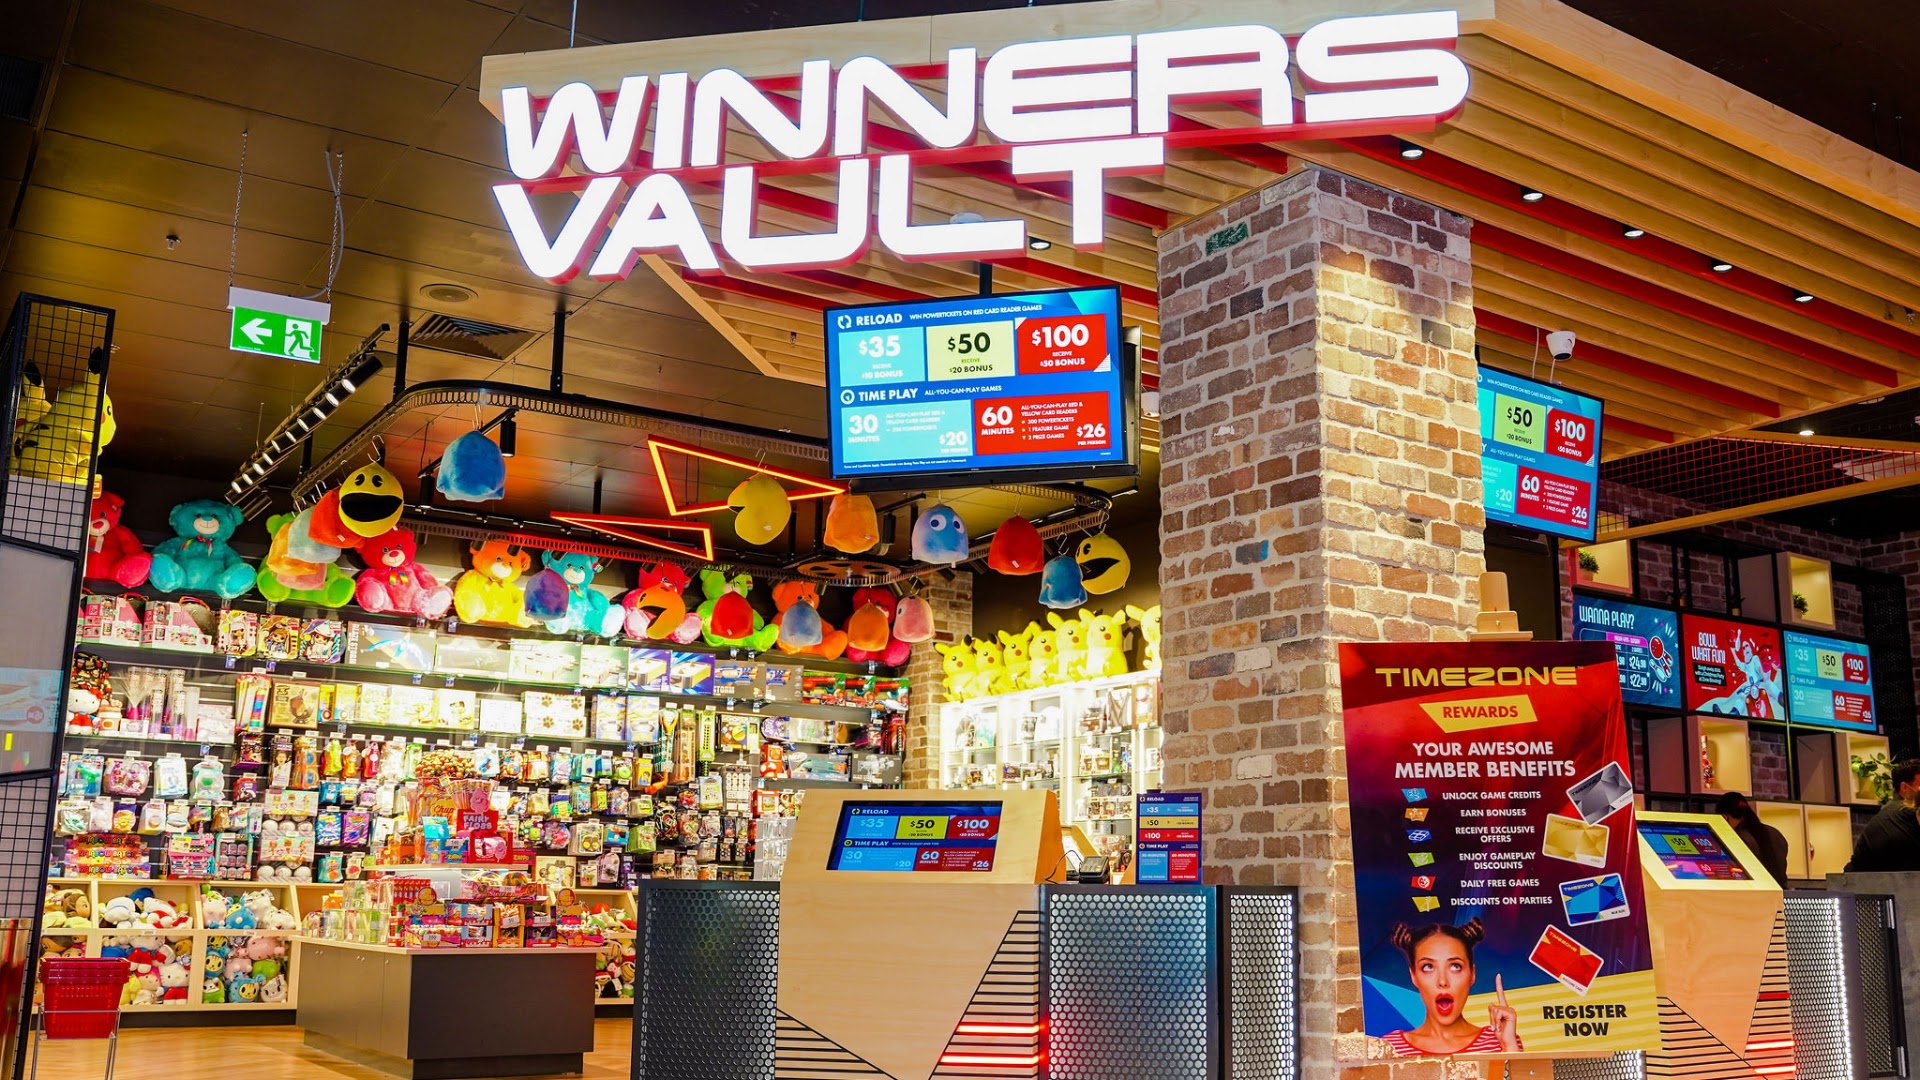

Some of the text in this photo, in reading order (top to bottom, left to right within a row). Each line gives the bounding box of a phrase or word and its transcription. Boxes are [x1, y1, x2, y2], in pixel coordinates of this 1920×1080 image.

[501, 9, 1470, 181] WINNERS
[491, 136, 1165, 281] VAULT
[922, 310, 962, 319] POWERTICKETS
[984, 307, 1000, 315] CARD
[1022, 304, 1042, 312] GAMES
[856, 313, 903, 326] RELOAD
[1031, 323, 1090, 348] $100
[859, 334, 901, 358] $35
[947, 332, 991, 354] $50
[1055, 358, 1085, 366] BONUS
[874, 370, 903, 378] BONUS
[949, 364, 993, 374] $20 BONUS
[858, 388, 918, 401] TIME PLAY
[924, 385, 1002, 396] ALL-YOU-CAN-PLAY GAMES
[981, 405, 1013, 427] 60
[1507, 406, 1532, 427] $50
[849, 414, 878, 434] 30
[981, 427, 1015, 435] MINUTES
[1076, 423, 1106, 438] $26
[1555, 418, 1586, 442] $100
[848, 435, 880, 443] MINUTES
[939, 431, 968, 446] $20
[1515, 434, 1532, 444] BONUS
[1565, 447, 1582, 457] BONUS
[1522, 475, 1539, 493] 60
[1495, 488, 1512, 502] $20
[1572, 506, 1587, 519] $26
[1579, 605, 1634, 629] WANNA PLAY?
[1698, 632, 1718, 649] BOWL
[1691, 645, 1726, 664] WHAT FUN!
[1795, 649, 1808, 660] $35
[1822, 655, 1836, 666] $50
[1847, 658, 1864, 671] $100
[1375, 666, 1577, 687] TIMEZONE
[1794, 690, 1804, 700] 30
[1835, 695, 1844, 706] 60
[1443, 705, 1518, 719] REWARDS
[1412, 741, 1554, 757] YOUR AWESOME
[1394, 760, 1576, 778] MEMBER BENEFITS
[1442, 791, 1541, 800] UNLOCK GAME CREDITS
[1460, 808, 1526, 817] EARN BONUSES
[860, 818, 885, 828] $35
[910, 819, 935, 829] $50
[957, 819, 989, 829] $100
[1455, 825, 1535, 835] RECEIVE EXCLUSIVE
[1480, 835, 1511, 843] OFFERS
[1694, 838, 1712, 846] $100
[845, 851, 862, 859] 30
[921, 851, 939, 860] 60
[1459, 852, 1536, 861] ENJOY GAMEPLAY
[972, 860, 989, 868] $26
[1474, 861, 1523, 870] DISCOUNTS
[1460, 878, 1540, 887] DAILY FREE GAMES
[1563, 883, 1594, 891] TIMEZONE
[1450, 896, 1553, 906] DISCOUNTS ON PARTIES
[1543, 1005, 1627, 1019] REGISTER
[1564, 1022, 1609, 1036] NOW
